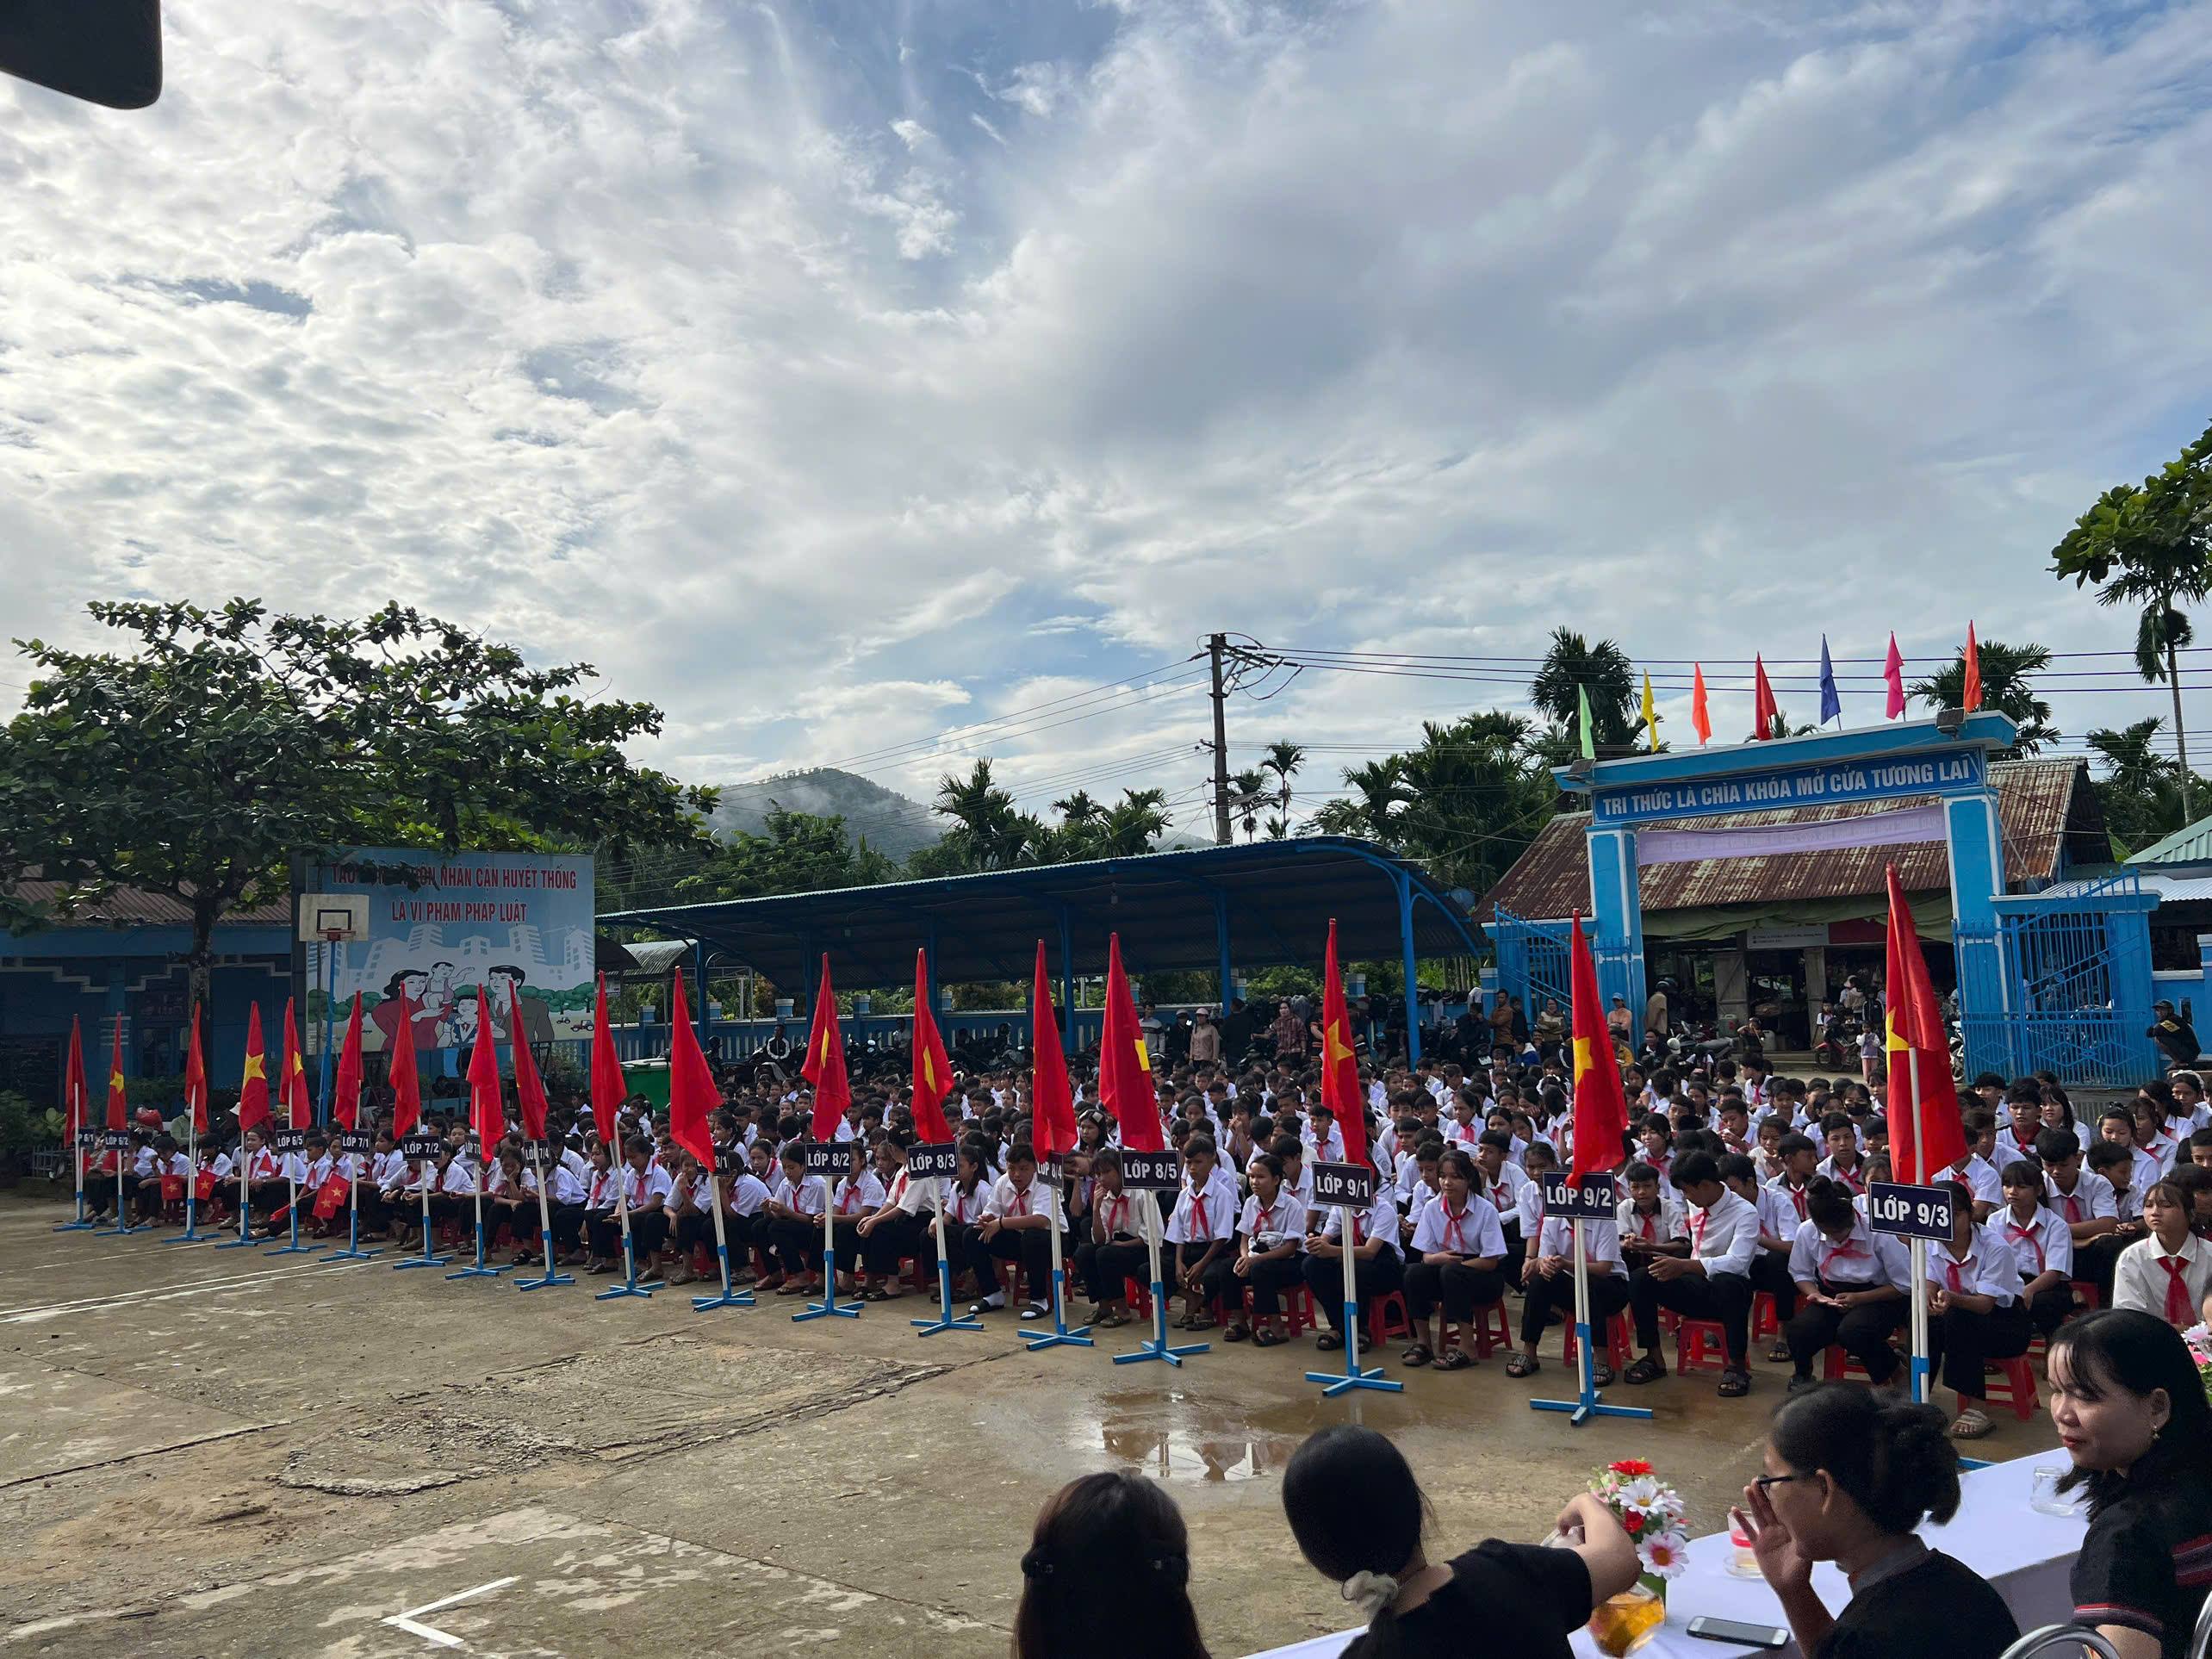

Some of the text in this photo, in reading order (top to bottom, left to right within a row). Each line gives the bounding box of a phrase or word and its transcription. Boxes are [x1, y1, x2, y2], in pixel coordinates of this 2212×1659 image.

[1603, 759, 1969, 816] TRI THỨC LÀ CHÌA KHÓA MỞ CỬA TƯƠNG LAI
[440, 863, 471, 886] NHÂN
[475, 863, 499, 891] CẬN
[503, 862, 537, 888] HUYẾT
[541, 863, 576, 889] THỐNG
[392, 896, 527, 926] LÀ VI PHẠM PHÁP LUẬT
[358, 1137, 369, 1148] 7/1
[404, 1141, 439, 1154] LỚP 7/2
[539, 1147, 550, 1160] 7/4
[714, 1155, 728, 1170] 8/1
[807, 1149, 850, 1167] LỚP 8/2
[910, 1153, 956, 1171] LỚP 8/3
[1051, 1163, 1062, 1180] 8/4
[1123, 1159, 1177, 1181] LỚP 8/5
[1316, 1172, 1369, 1198] LỚP 9/1
[1583, 1187, 1612, 1209] 9/2
[1873, 1194, 1949, 1227] LỚP 9/3
